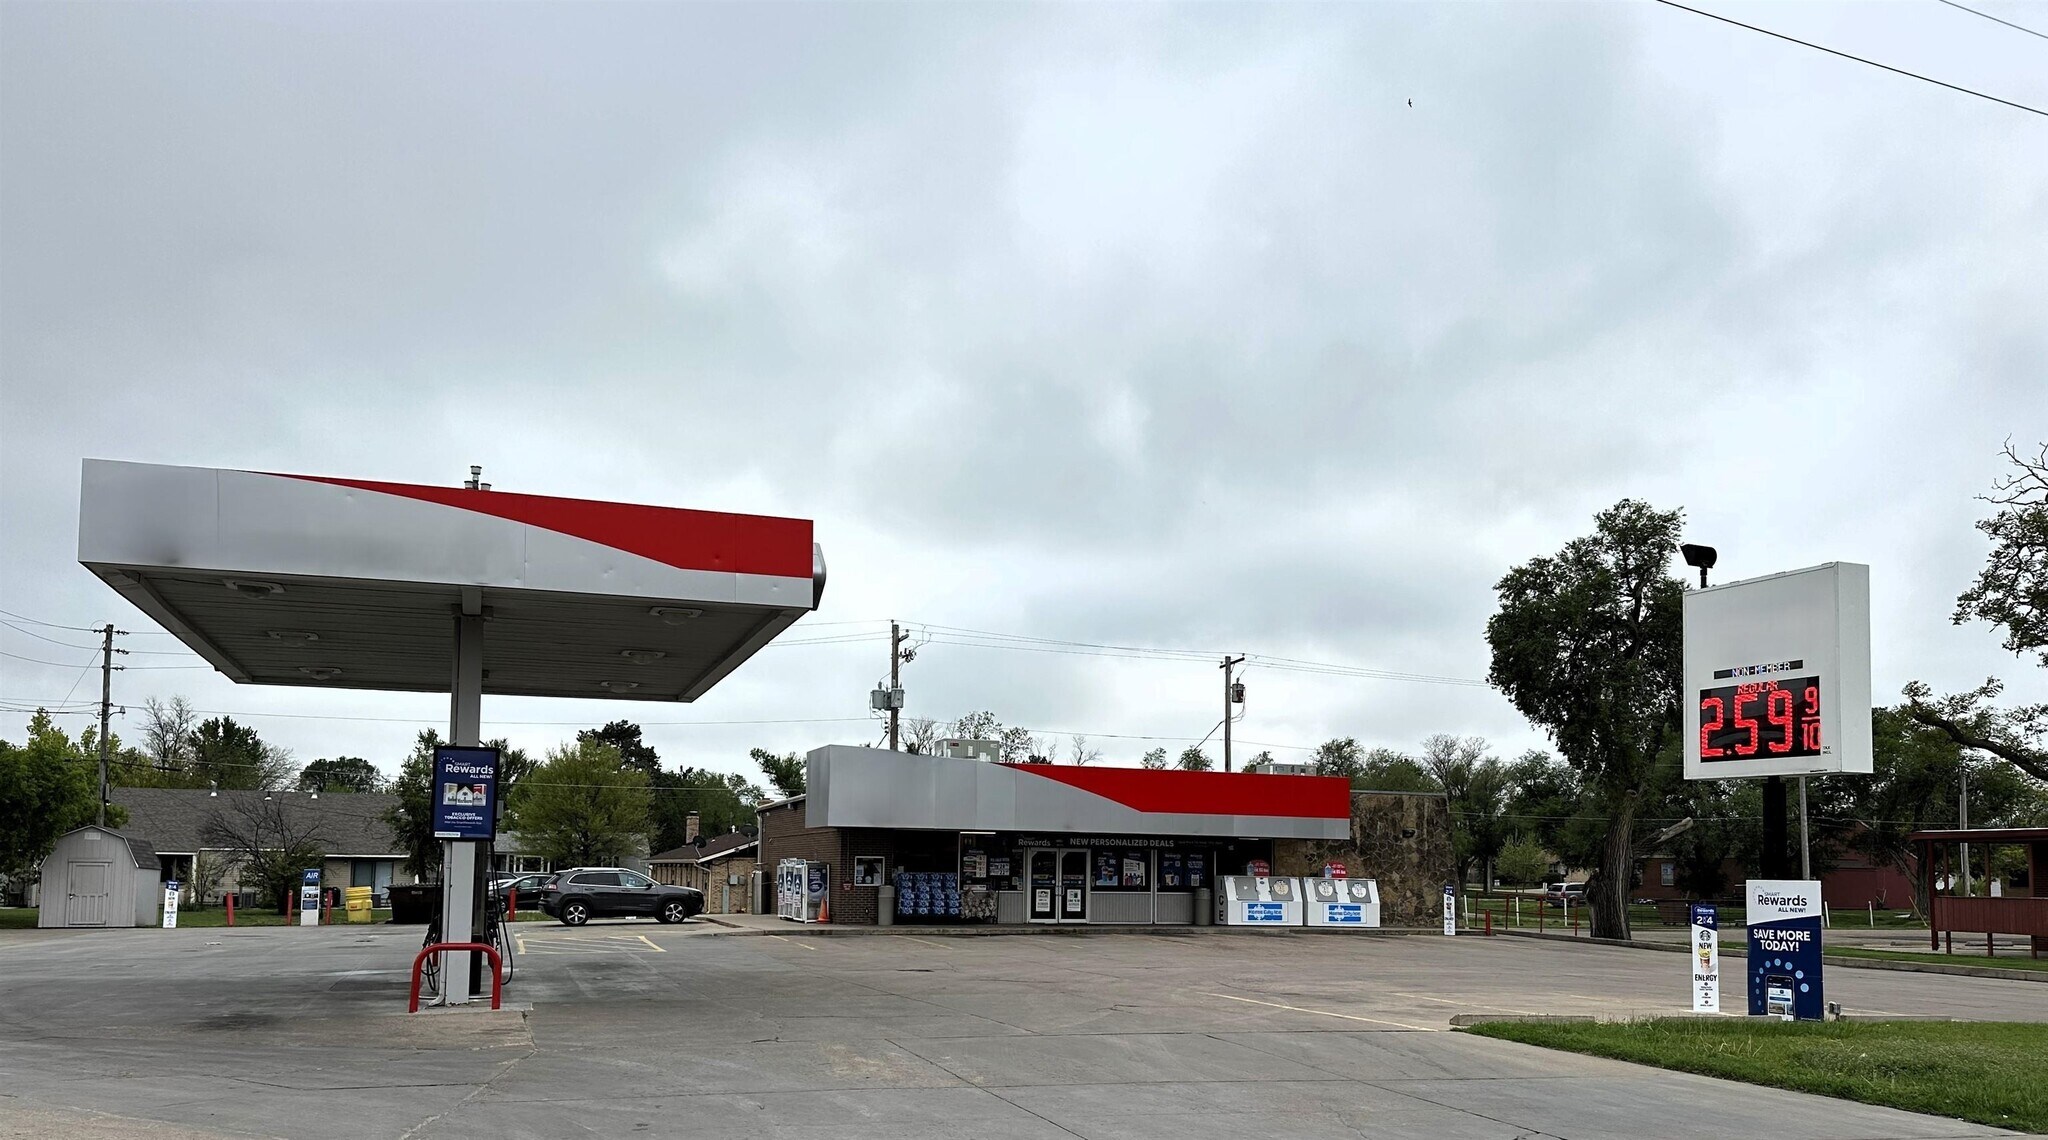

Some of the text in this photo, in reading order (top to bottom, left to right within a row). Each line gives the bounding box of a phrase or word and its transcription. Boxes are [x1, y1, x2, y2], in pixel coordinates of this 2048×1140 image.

[1732, 662, 1791, 677] NON-MEMBER
[1737, 680, 1778, 694] REGULAR
[1701, 689, 1793, 757] 2.59
[445, 763, 494, 774] Rewards
[1018, 838, 1051, 846] Rewards
[1070, 838, 1089, 846] NEW
[1090, 838, 1149, 847] PERSONALIZED
[1149, 839, 1175, 847] DEALS
[1757, 895, 1808, 907] Rewards
[1753, 928, 1811, 942] SAVE MORE
[1760, 940, 1799, 952] TODAY!
[1694, 974, 1717, 982] ENERGY
